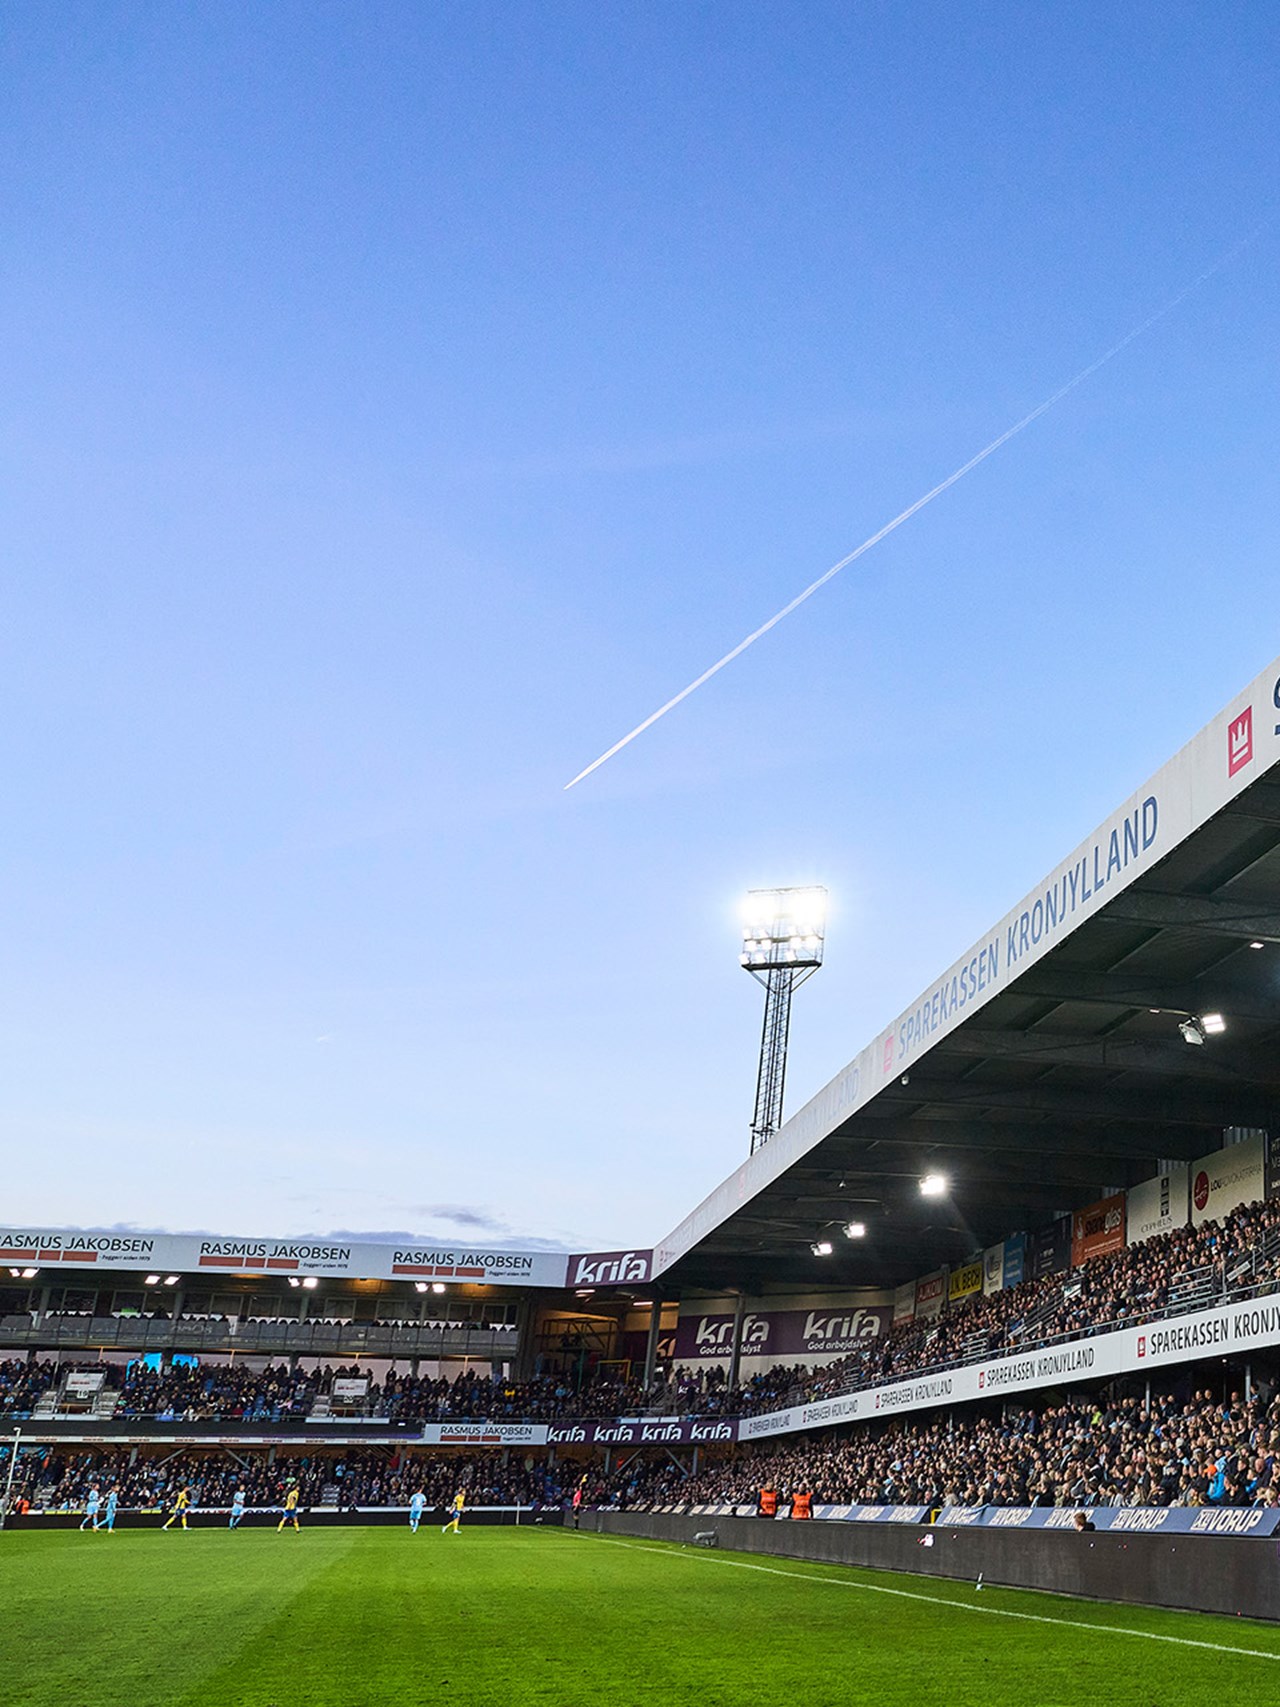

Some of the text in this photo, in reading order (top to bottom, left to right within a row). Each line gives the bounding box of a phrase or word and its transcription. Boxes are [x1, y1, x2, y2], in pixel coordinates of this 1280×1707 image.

[899, 794, 1160, 1060] SPAREKASSEN KRONJYLLAND
[0, 1234, 154, 1252] ASMUS JAKOBSEN
[200, 1242, 351, 1260] RASMUS JAKOBSEN
[393, 1251, 533, 1269] RASMUS JAKOBSEN
[574, 1252, 648, 1285] krifa
[695, 1314, 771, 1345] krfa
[803, 1309, 881, 1340] krifa
[808, 1340, 824, 1350] God
[1149, 1318, 1230, 1356] SPAREKASSEN
[700, 1345, 717, 1355] God
[986, 1348, 1095, 1387] SPAREKASSEN KRONJYLLAND
[440, 1426, 533, 1435] RASMUS JAKOBSEN
[547, 1425, 586, 1442] krifa
[593, 1425, 634, 1441] krifa
[640, 1424, 683, 1441] krifa
[690, 1422, 733, 1440] krifa
[1124, 1509, 1169, 1529] VORUP
[1208, 1509, 1263, 1532] VORUP
